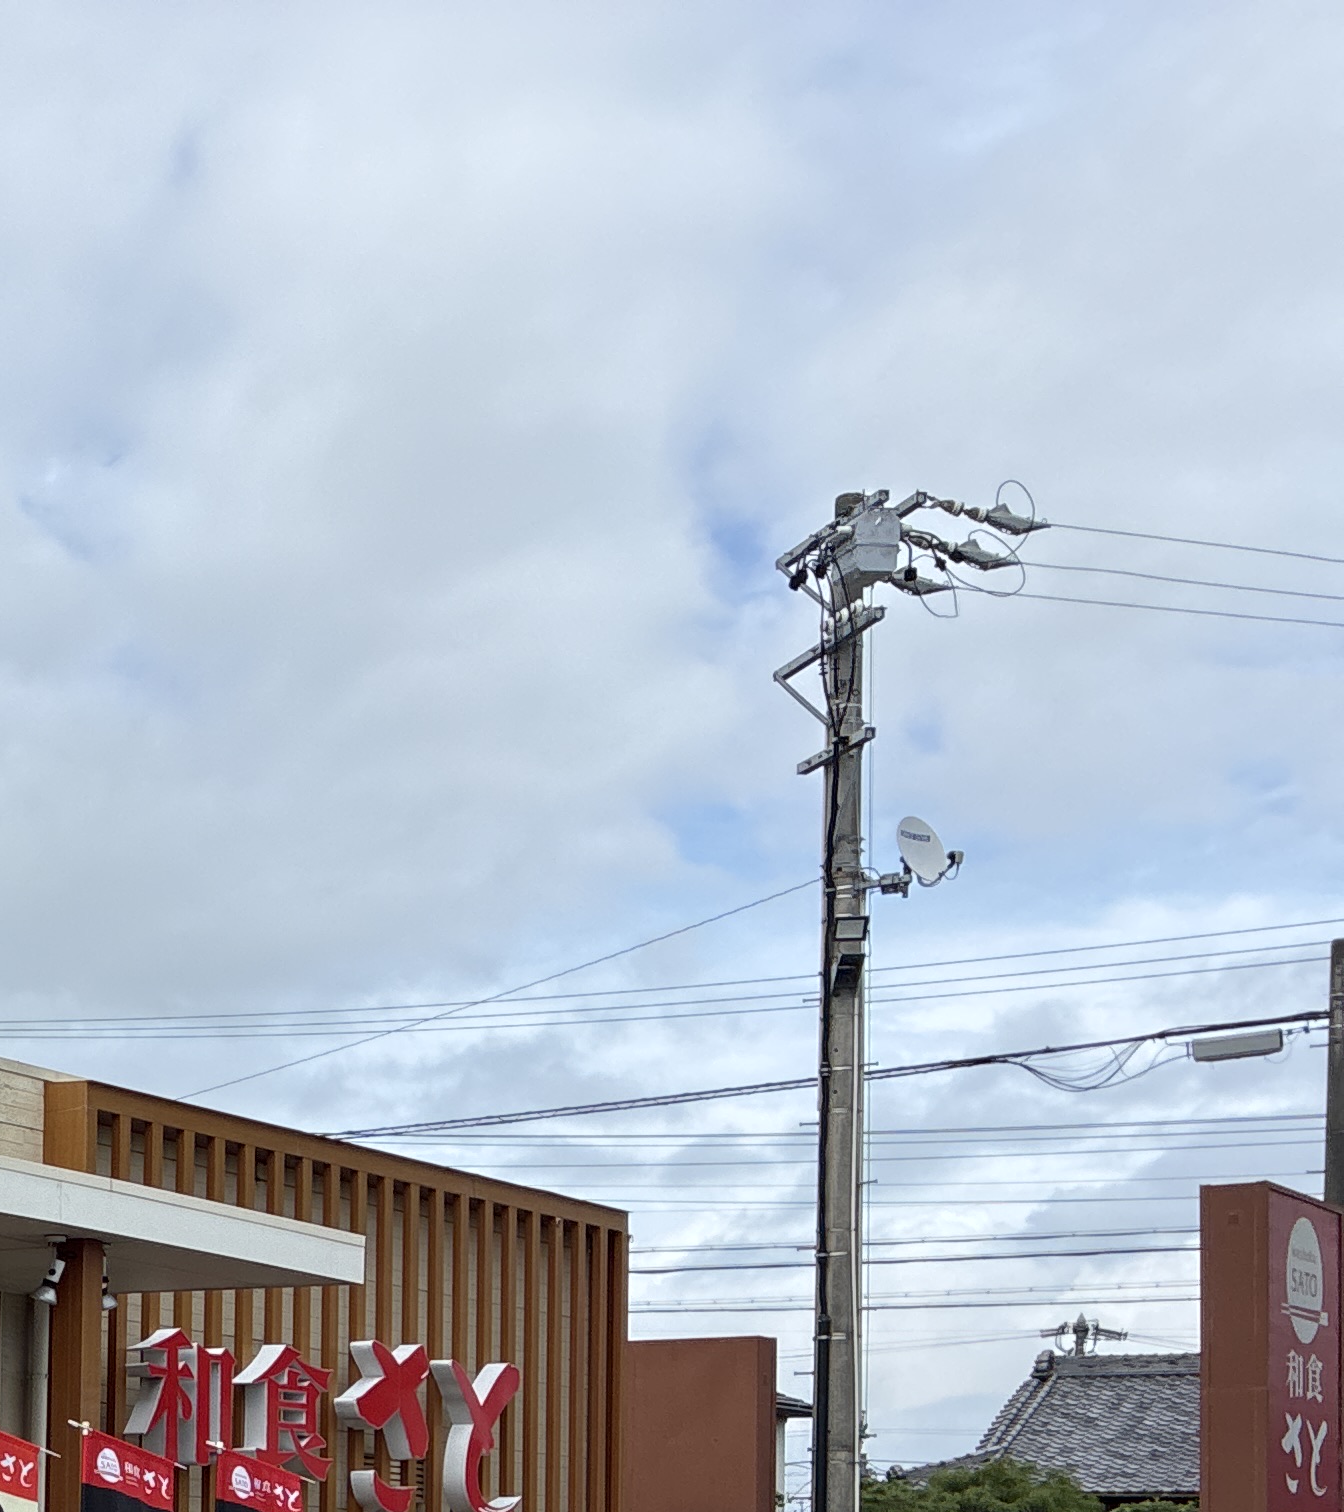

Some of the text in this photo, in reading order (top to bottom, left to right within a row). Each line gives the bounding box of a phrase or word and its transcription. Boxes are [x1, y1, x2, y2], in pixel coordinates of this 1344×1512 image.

[1285, 1350, 1324, 1403] 和食
[1281, 1412, 1329, 1497] さと
[124, 1461, 171, 1500] 和食さと
[254, 1477, 302, 1512] 和食さと
